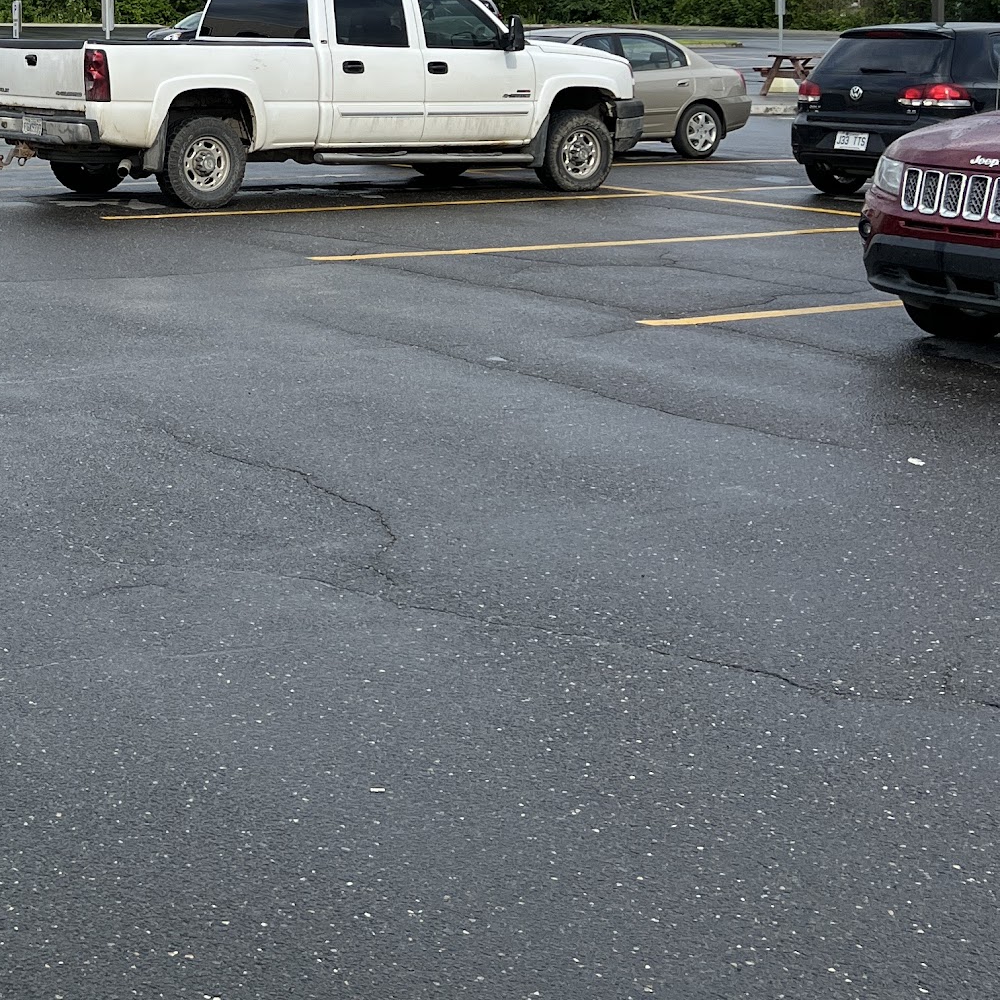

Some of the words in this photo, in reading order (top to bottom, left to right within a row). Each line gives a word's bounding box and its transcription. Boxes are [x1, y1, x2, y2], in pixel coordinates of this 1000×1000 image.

[836, 135, 849, 145] J33
[853, 136, 866, 147] TTS
[969, 155, 1000, 168] Jeep
